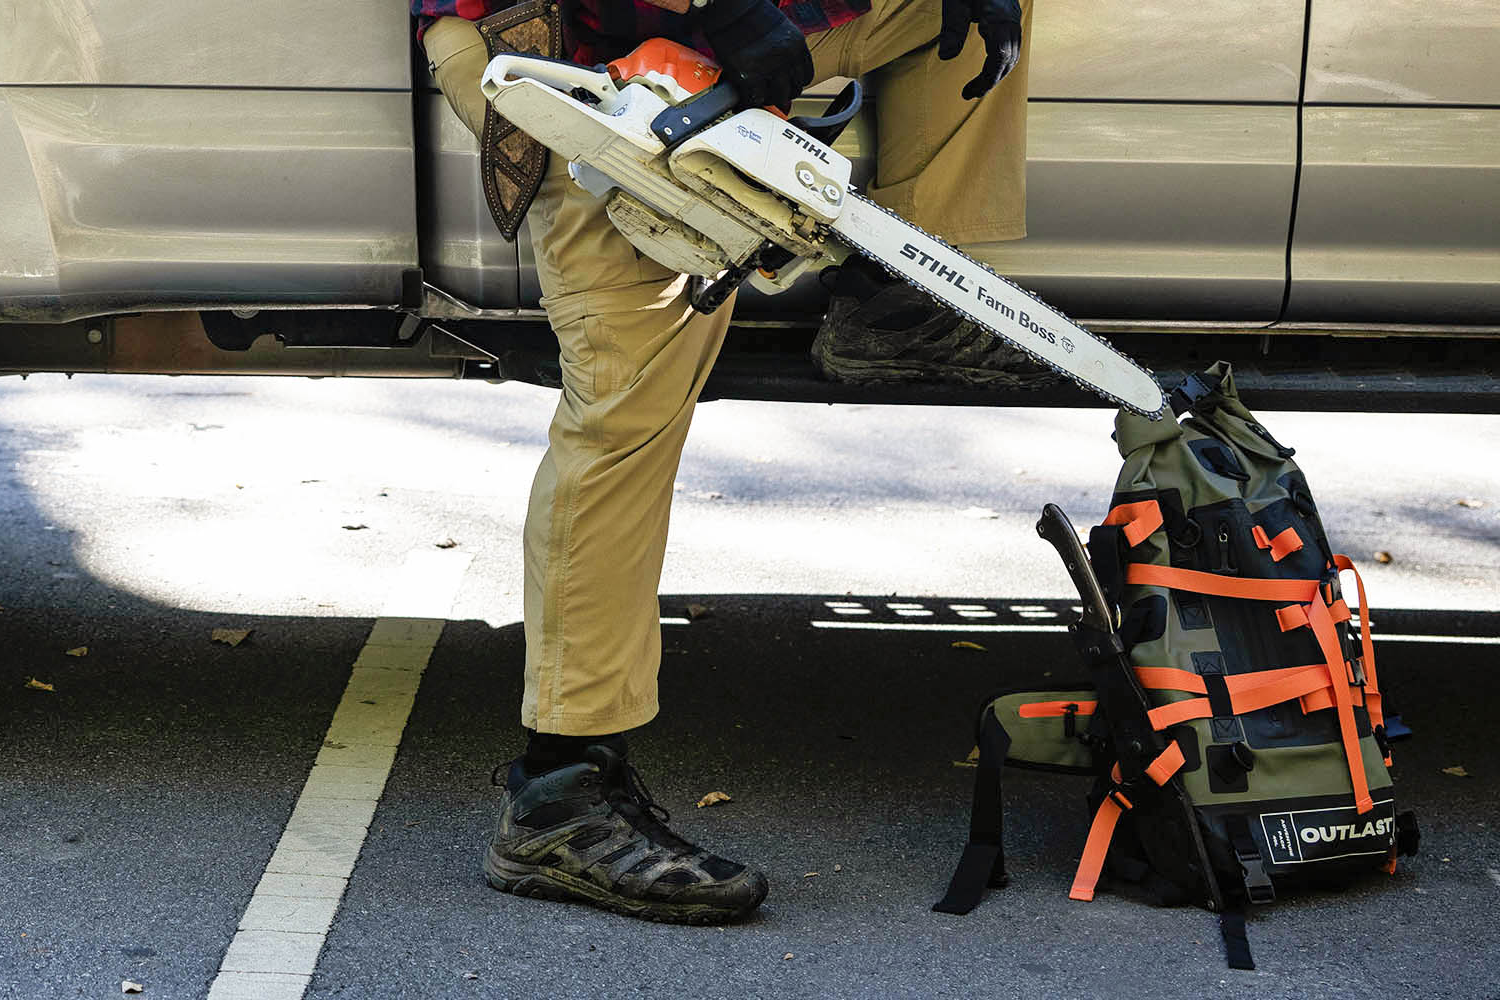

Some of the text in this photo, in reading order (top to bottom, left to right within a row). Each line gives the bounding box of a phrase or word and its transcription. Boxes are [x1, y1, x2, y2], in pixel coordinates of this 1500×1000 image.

[781, 127, 831, 166] STIHL
[900, 242, 1056, 345] STIHL Farm Boss
[1300, 816, 1393, 844] OUTLAST
